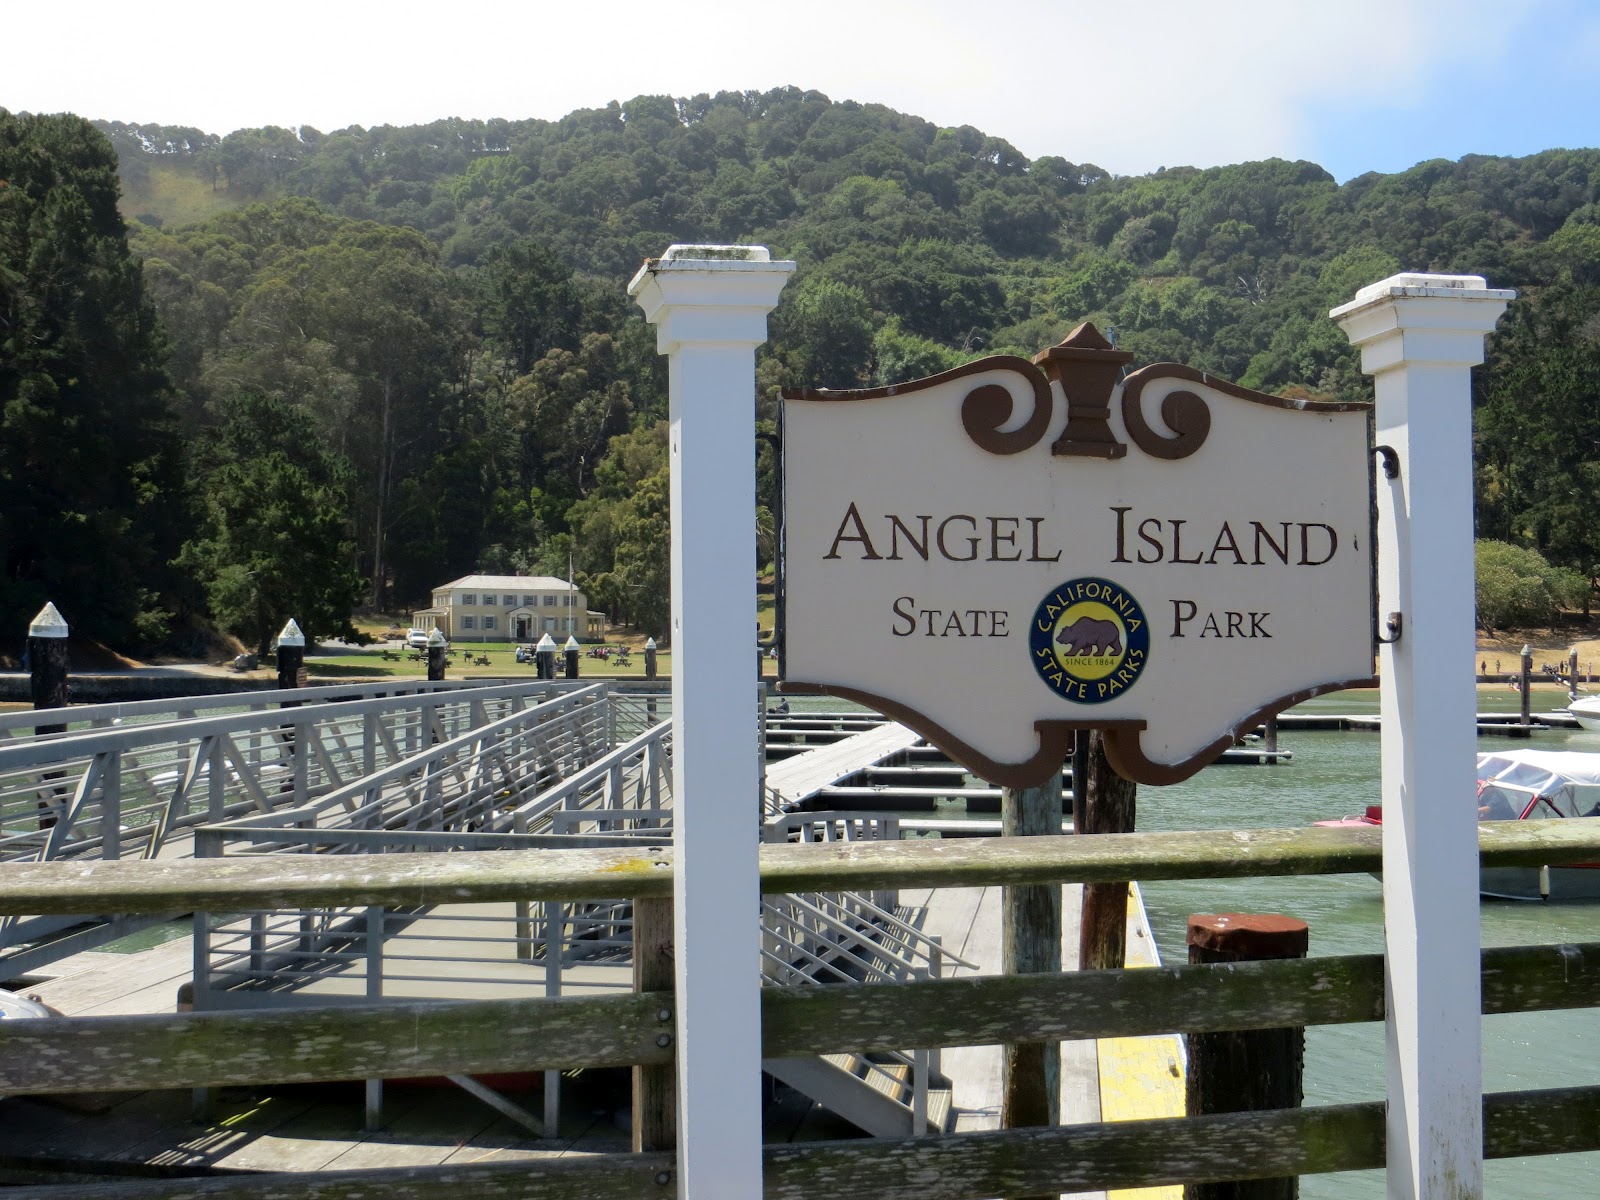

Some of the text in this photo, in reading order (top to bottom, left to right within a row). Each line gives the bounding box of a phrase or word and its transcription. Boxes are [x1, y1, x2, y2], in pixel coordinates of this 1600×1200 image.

[823, 502, 1337, 566] ANGEL ISLAND
[893, 597, 1272, 638] STATE PARK
[1038, 582, 1142, 633] CALIFORNIA
[1036, 647, 1144, 699] STATE PARKS
